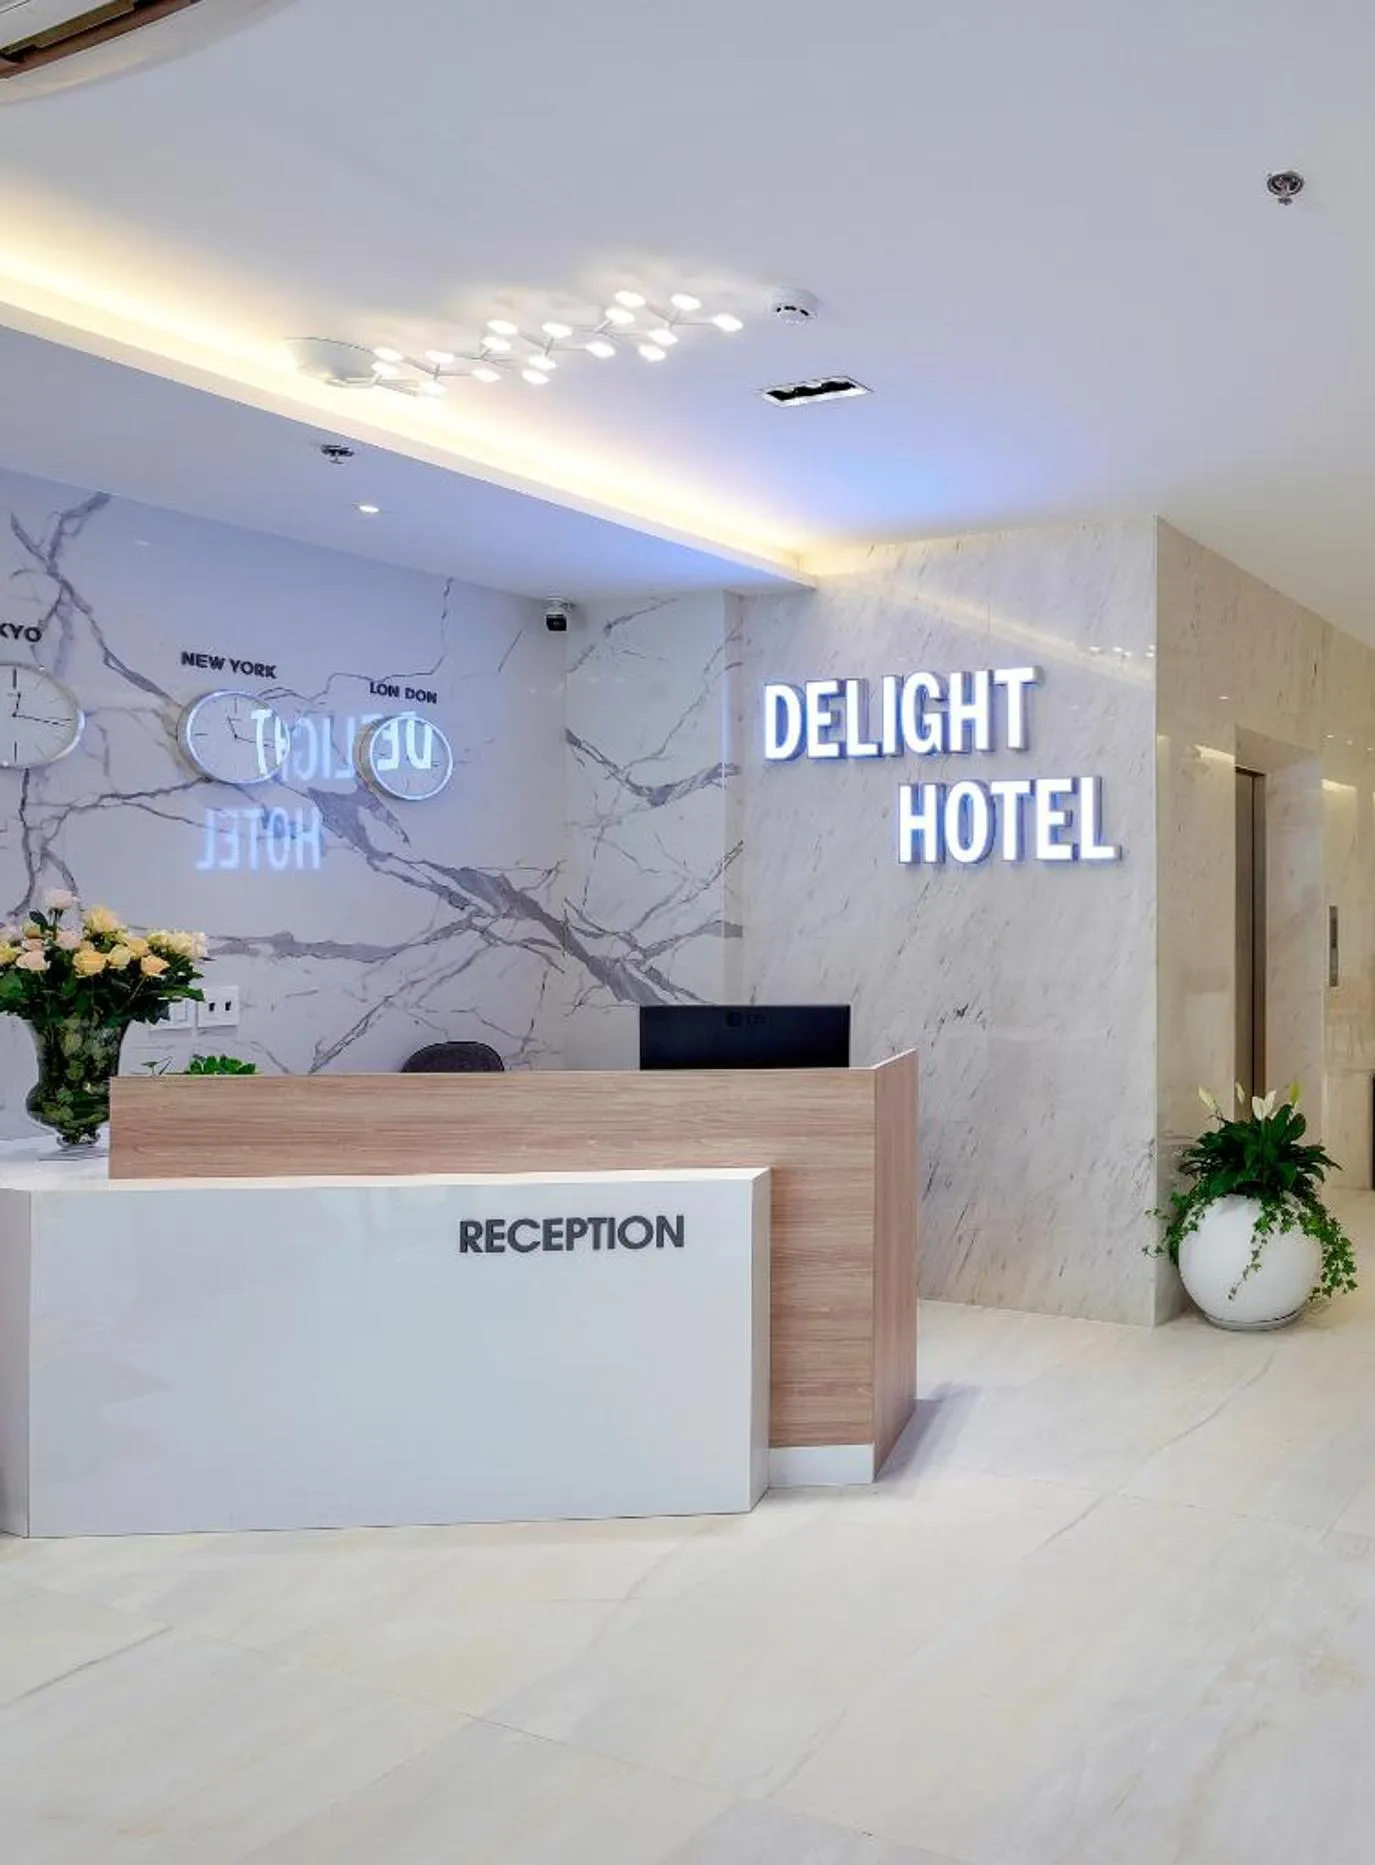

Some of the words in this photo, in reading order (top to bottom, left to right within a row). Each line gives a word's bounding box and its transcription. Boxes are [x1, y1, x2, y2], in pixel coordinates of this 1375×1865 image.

[181, 651, 226, 670] NEW
[229, 658, 277, 679] YORK
[764, 666, 1041, 760] DELIGHT
[898, 776, 1118, 864] HOTEL
[459, 1215, 684, 1253] RECEPTION
